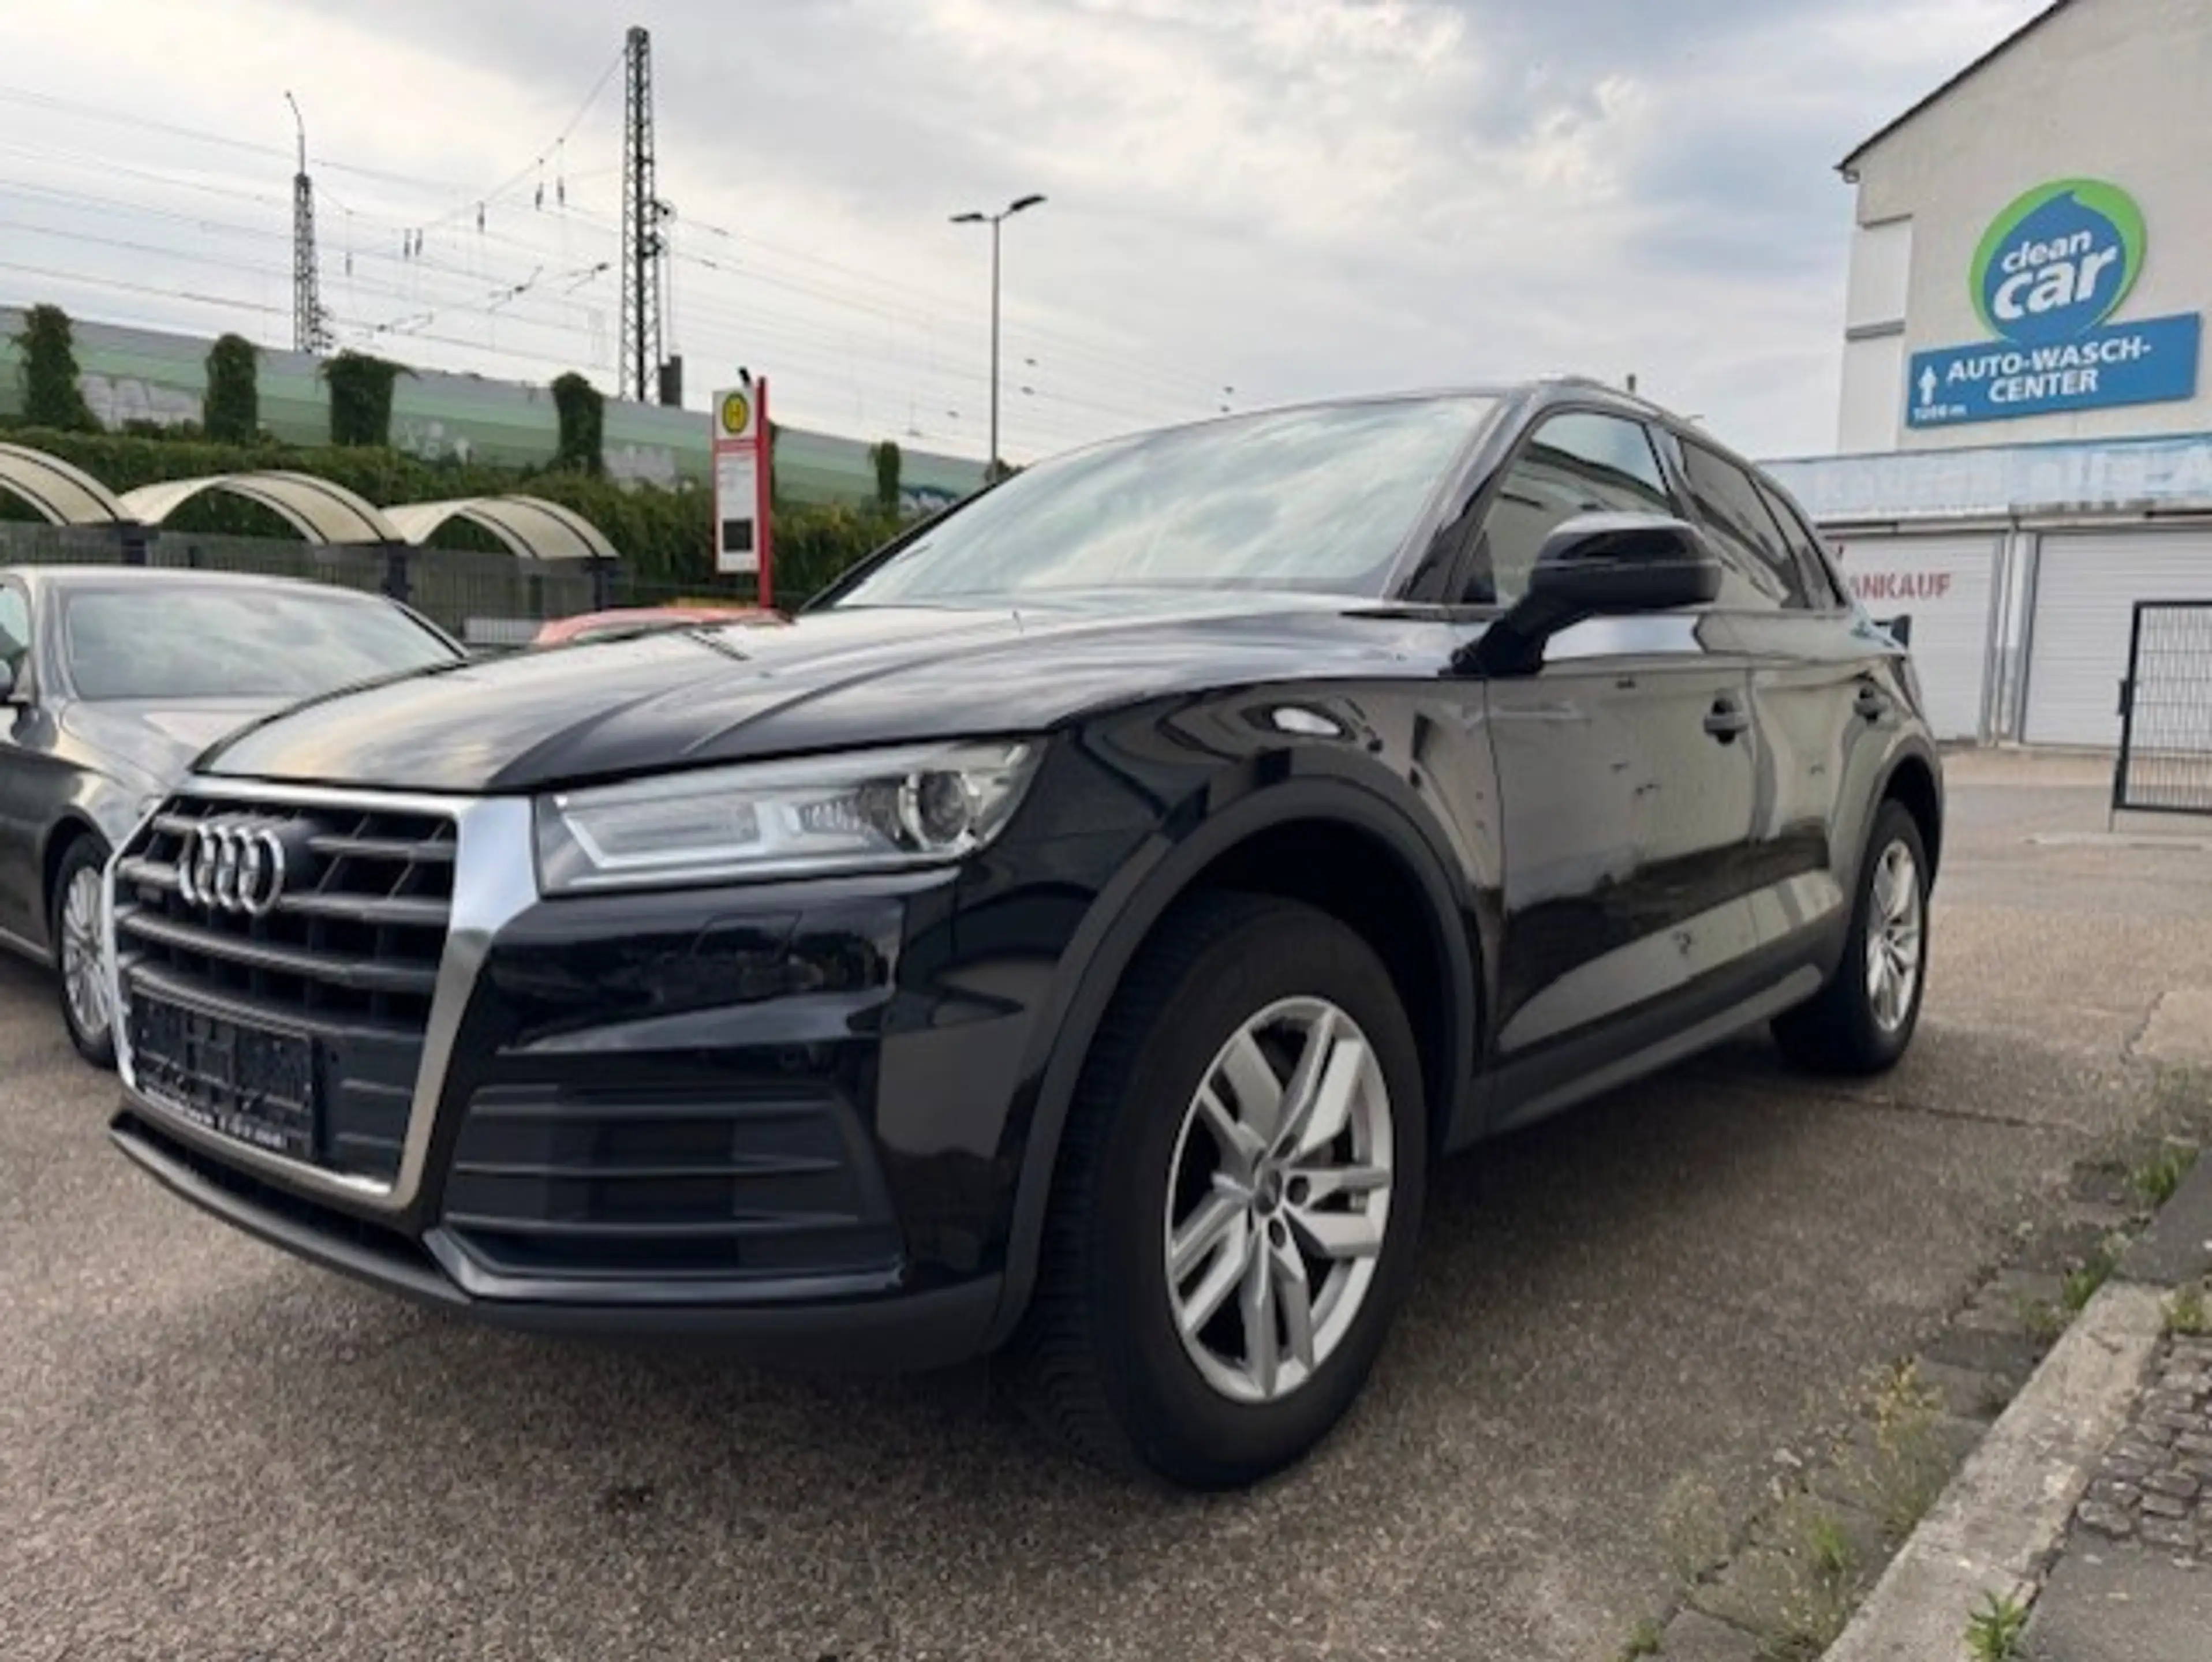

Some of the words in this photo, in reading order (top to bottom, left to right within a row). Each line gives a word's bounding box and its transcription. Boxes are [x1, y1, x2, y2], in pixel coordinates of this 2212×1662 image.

[2001, 230, 2092, 274] clean
[1994, 246, 2118, 319] car
[1946, 335, 2151, 384] AUTO-WASCH-
[1988, 368, 2099, 402] CENTER
